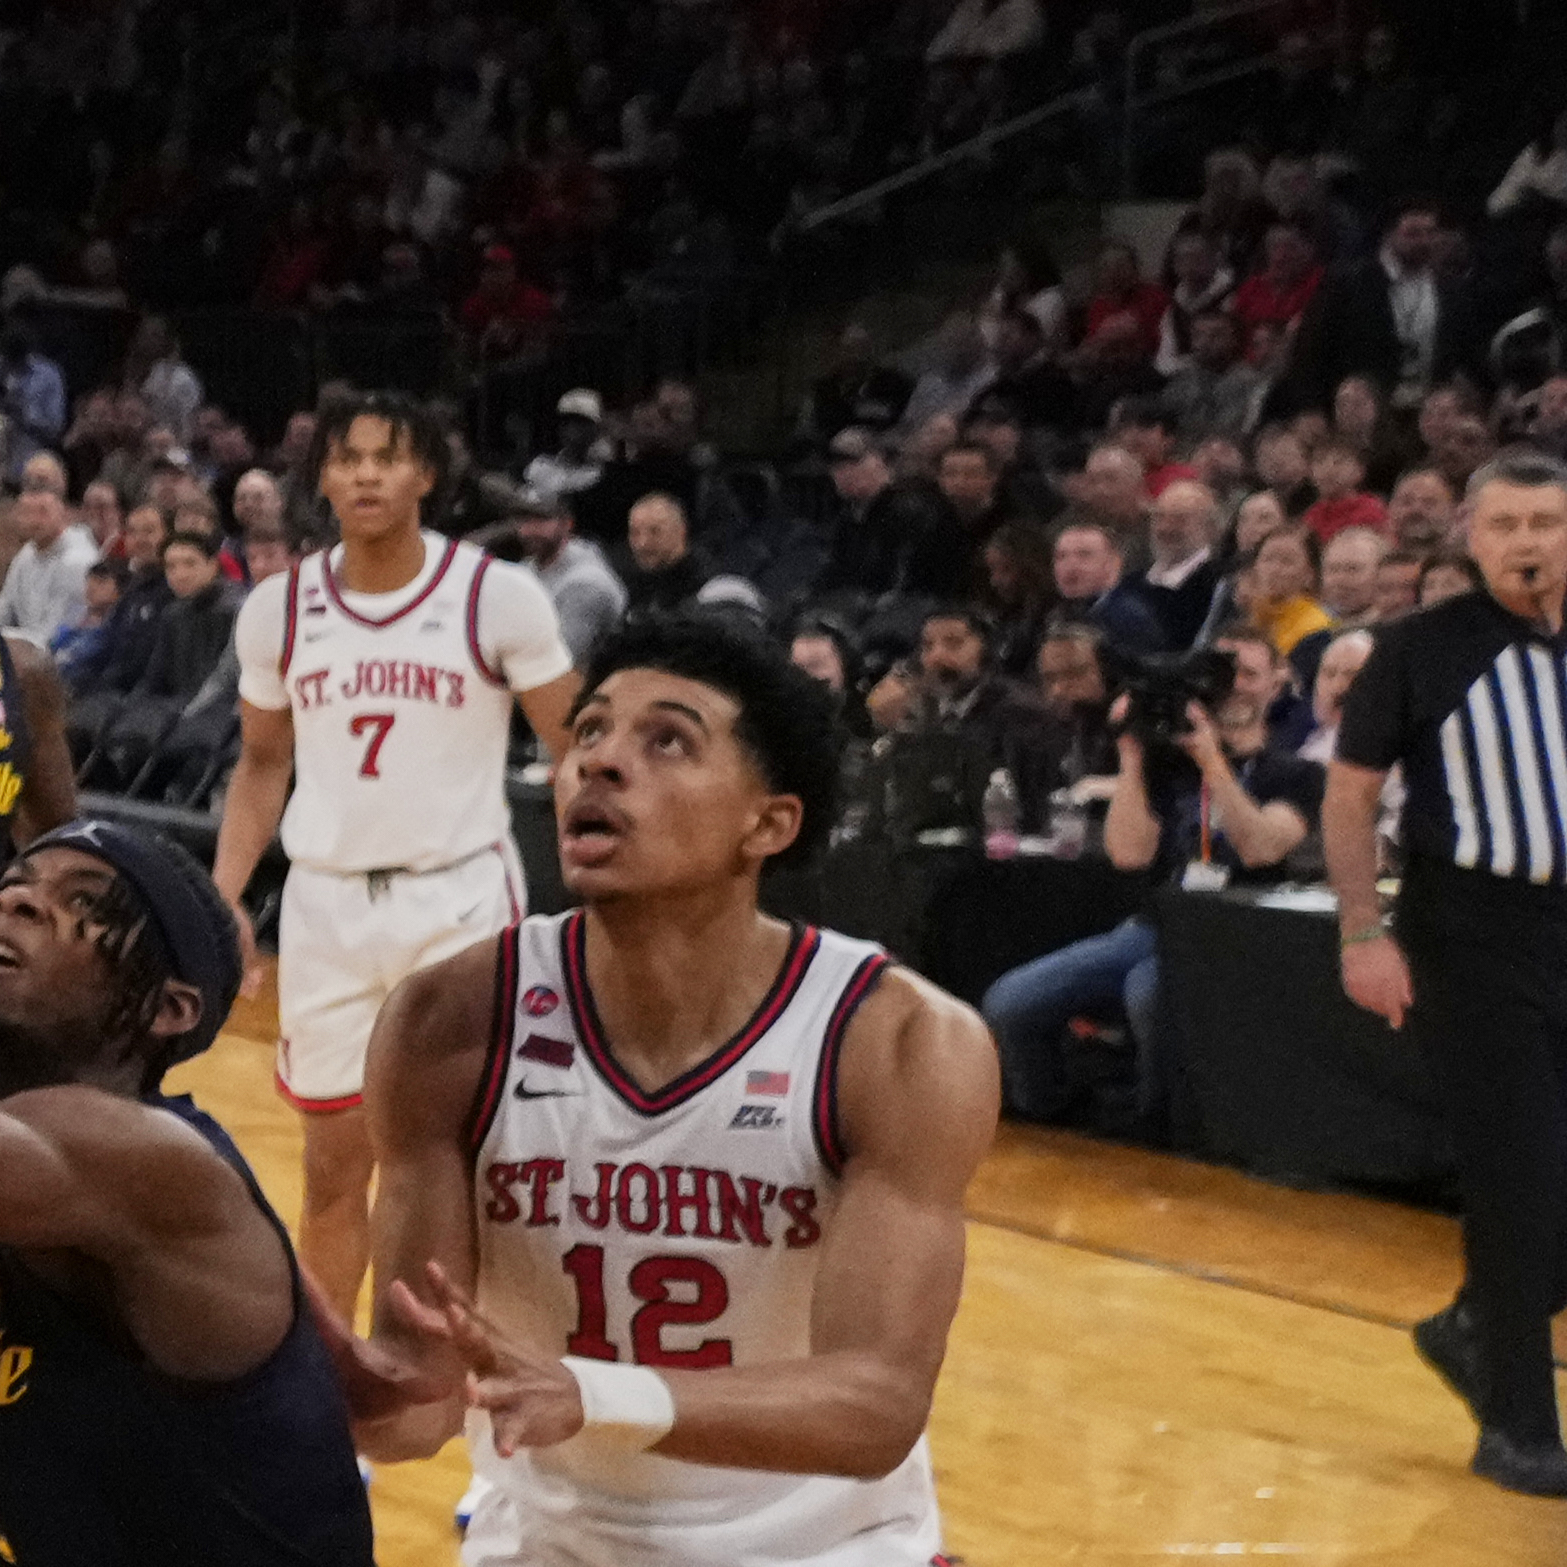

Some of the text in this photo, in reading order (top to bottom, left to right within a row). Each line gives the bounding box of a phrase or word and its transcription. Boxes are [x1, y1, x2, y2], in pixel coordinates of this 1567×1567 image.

[340, 660, 466, 710] JOHN'S
[349, 708, 396, 781] 7
[571, 1162, 821, 1249] JOHN'S
[562, 1242, 733, 1370] 12
